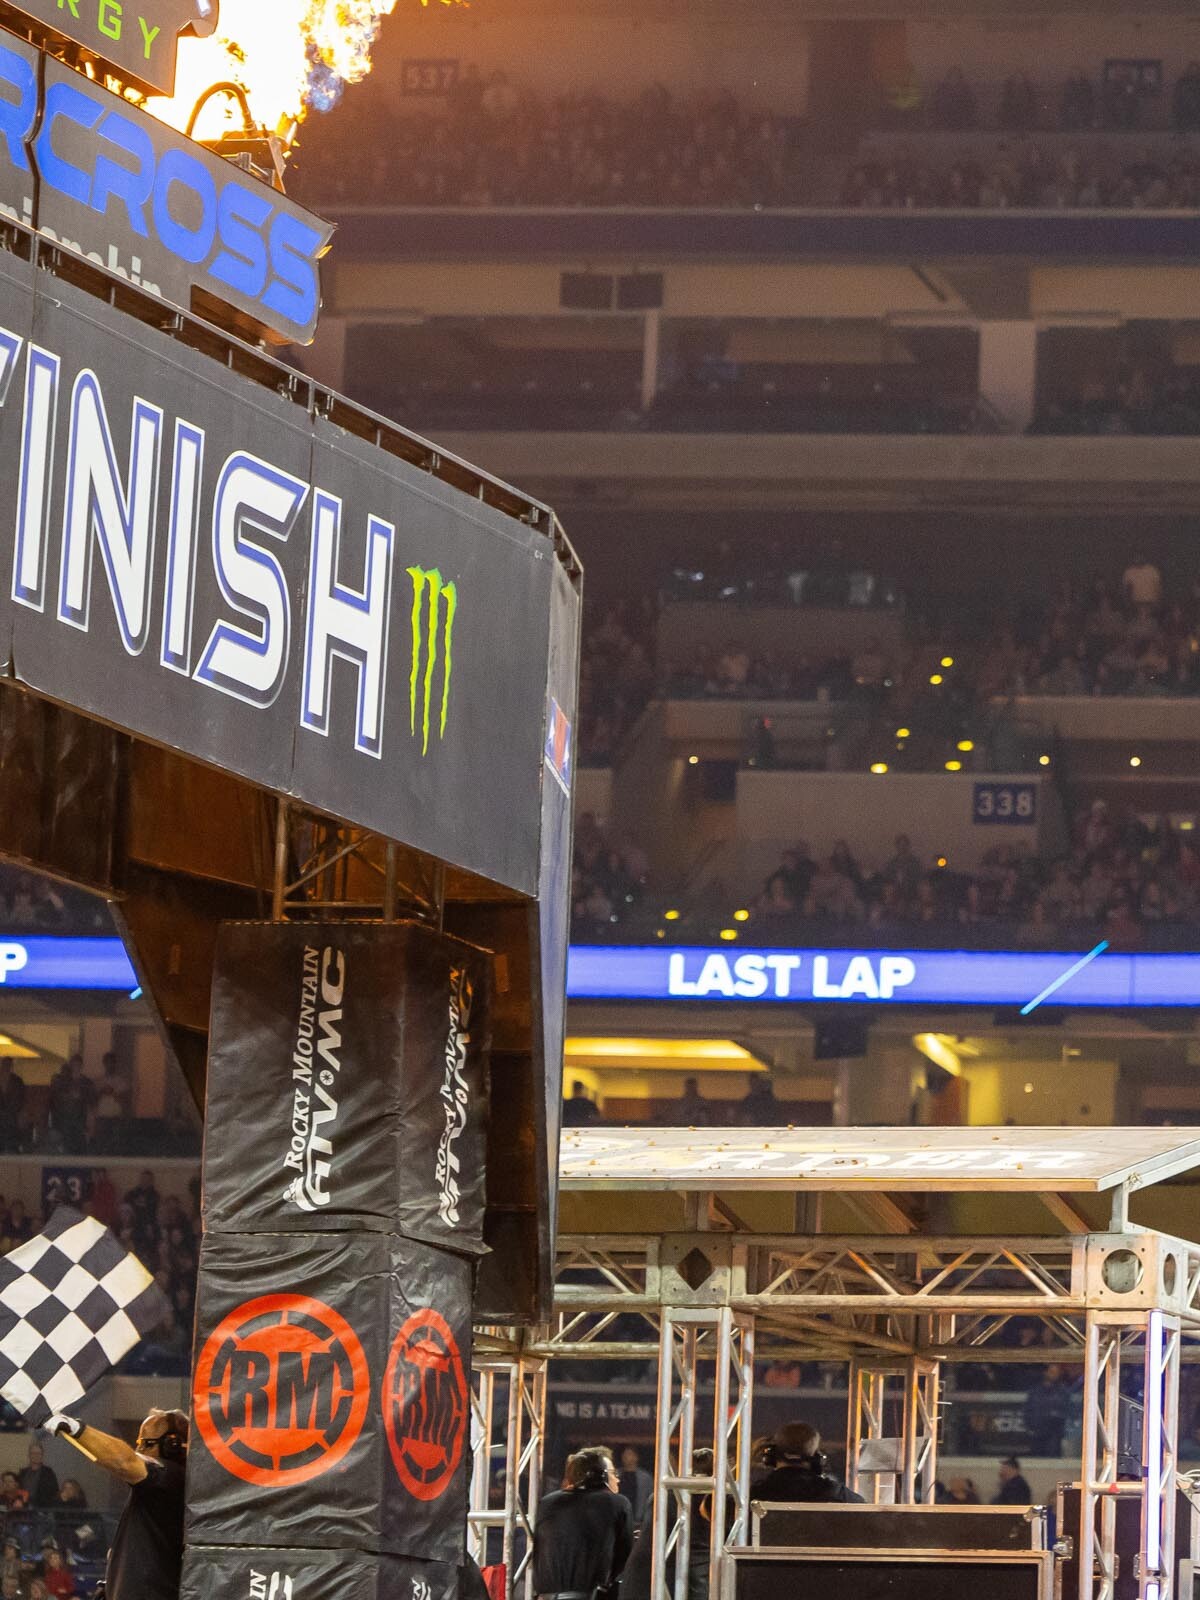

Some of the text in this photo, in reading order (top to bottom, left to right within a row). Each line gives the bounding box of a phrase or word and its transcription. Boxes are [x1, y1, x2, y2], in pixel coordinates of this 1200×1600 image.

[0, 326, 396, 760] INISH
[978, 791, 1032, 816] 338
[669, 953, 916, 999] LAST LAP
[283, 945, 319, 1172] ROCKY MOUNTAIN
[222, 1349, 344, 1431] RM
